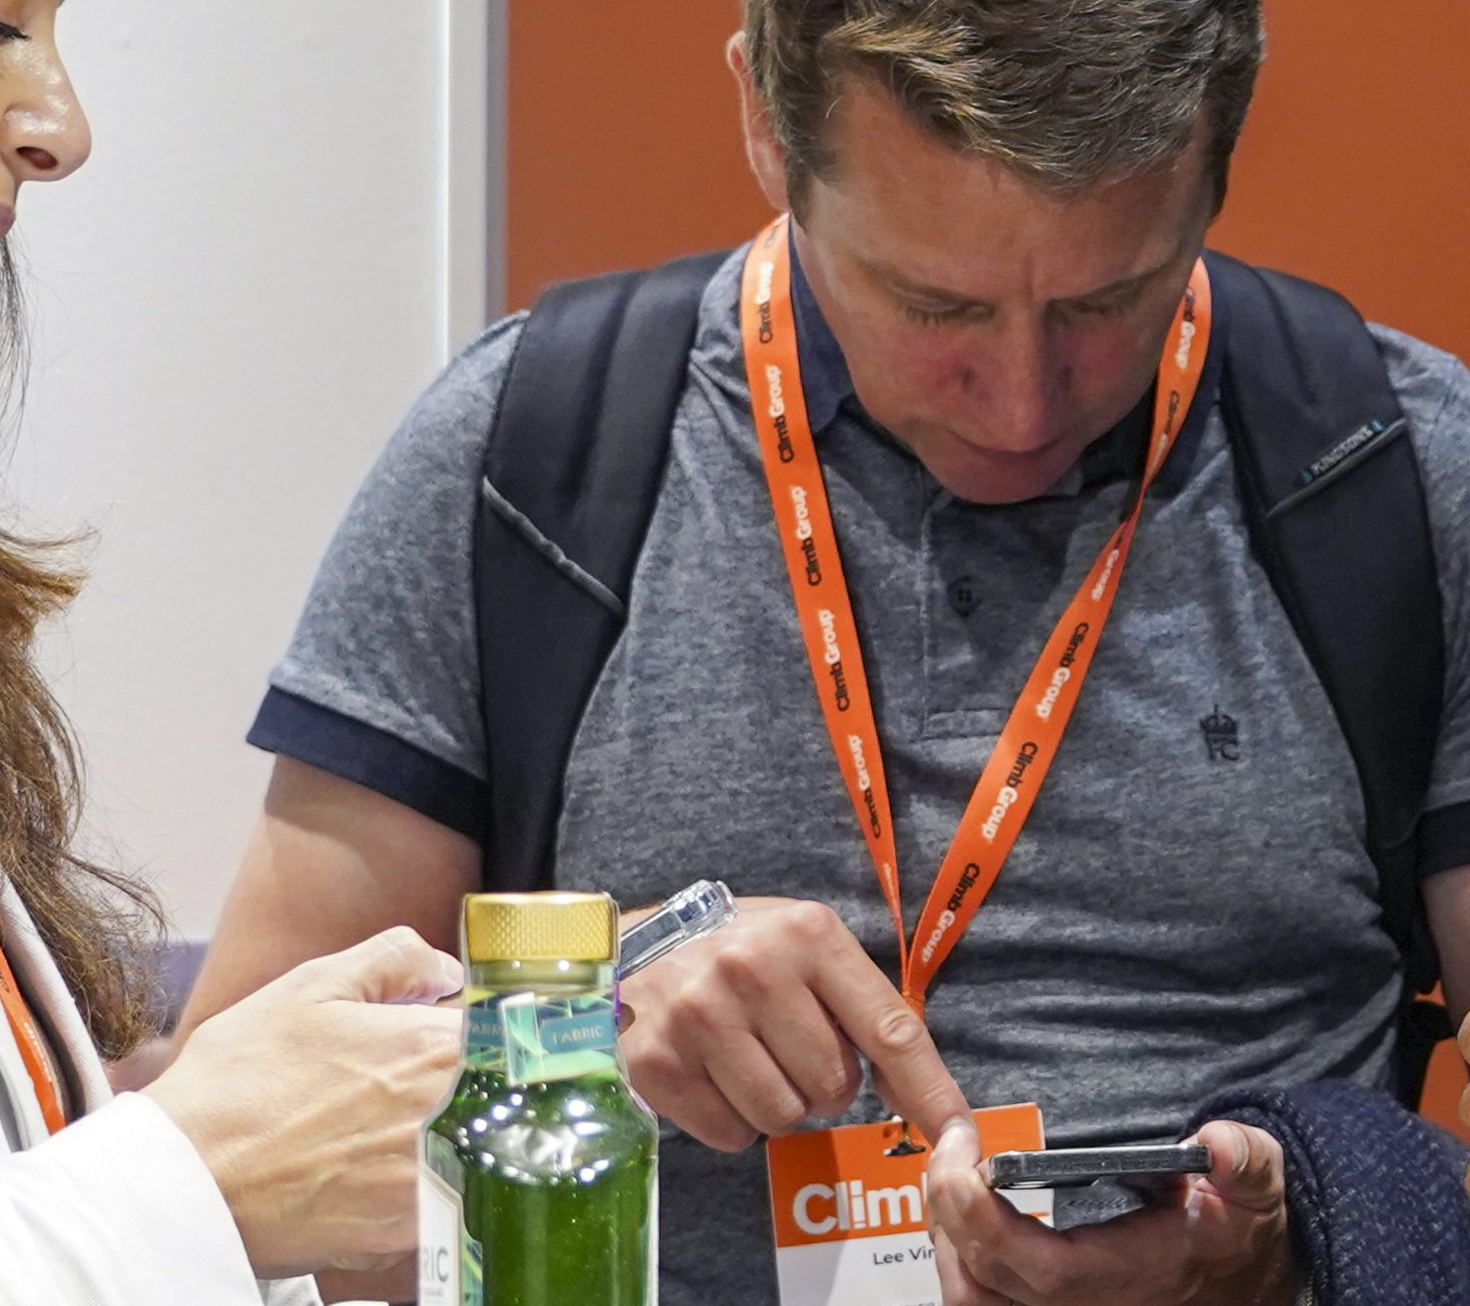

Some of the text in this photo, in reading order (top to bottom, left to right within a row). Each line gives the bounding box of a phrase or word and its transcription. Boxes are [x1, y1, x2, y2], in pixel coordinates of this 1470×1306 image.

[765, 363, 796, 464] ClimbGroup
[789, 484, 823, 587] ClimbGroup
[817, 608, 851, 713] ClimbGroup
[1035, 621, 1090, 723] ClimbGroup
[981, 740, 1039, 845] ClimbGroup
[920, 861, 981, 966] ClimbGroup
[792, 1171, 928, 1236] Clim
[422, 1244, 450, 1283] RIC
[873, 1251, 904, 1266] Lee
